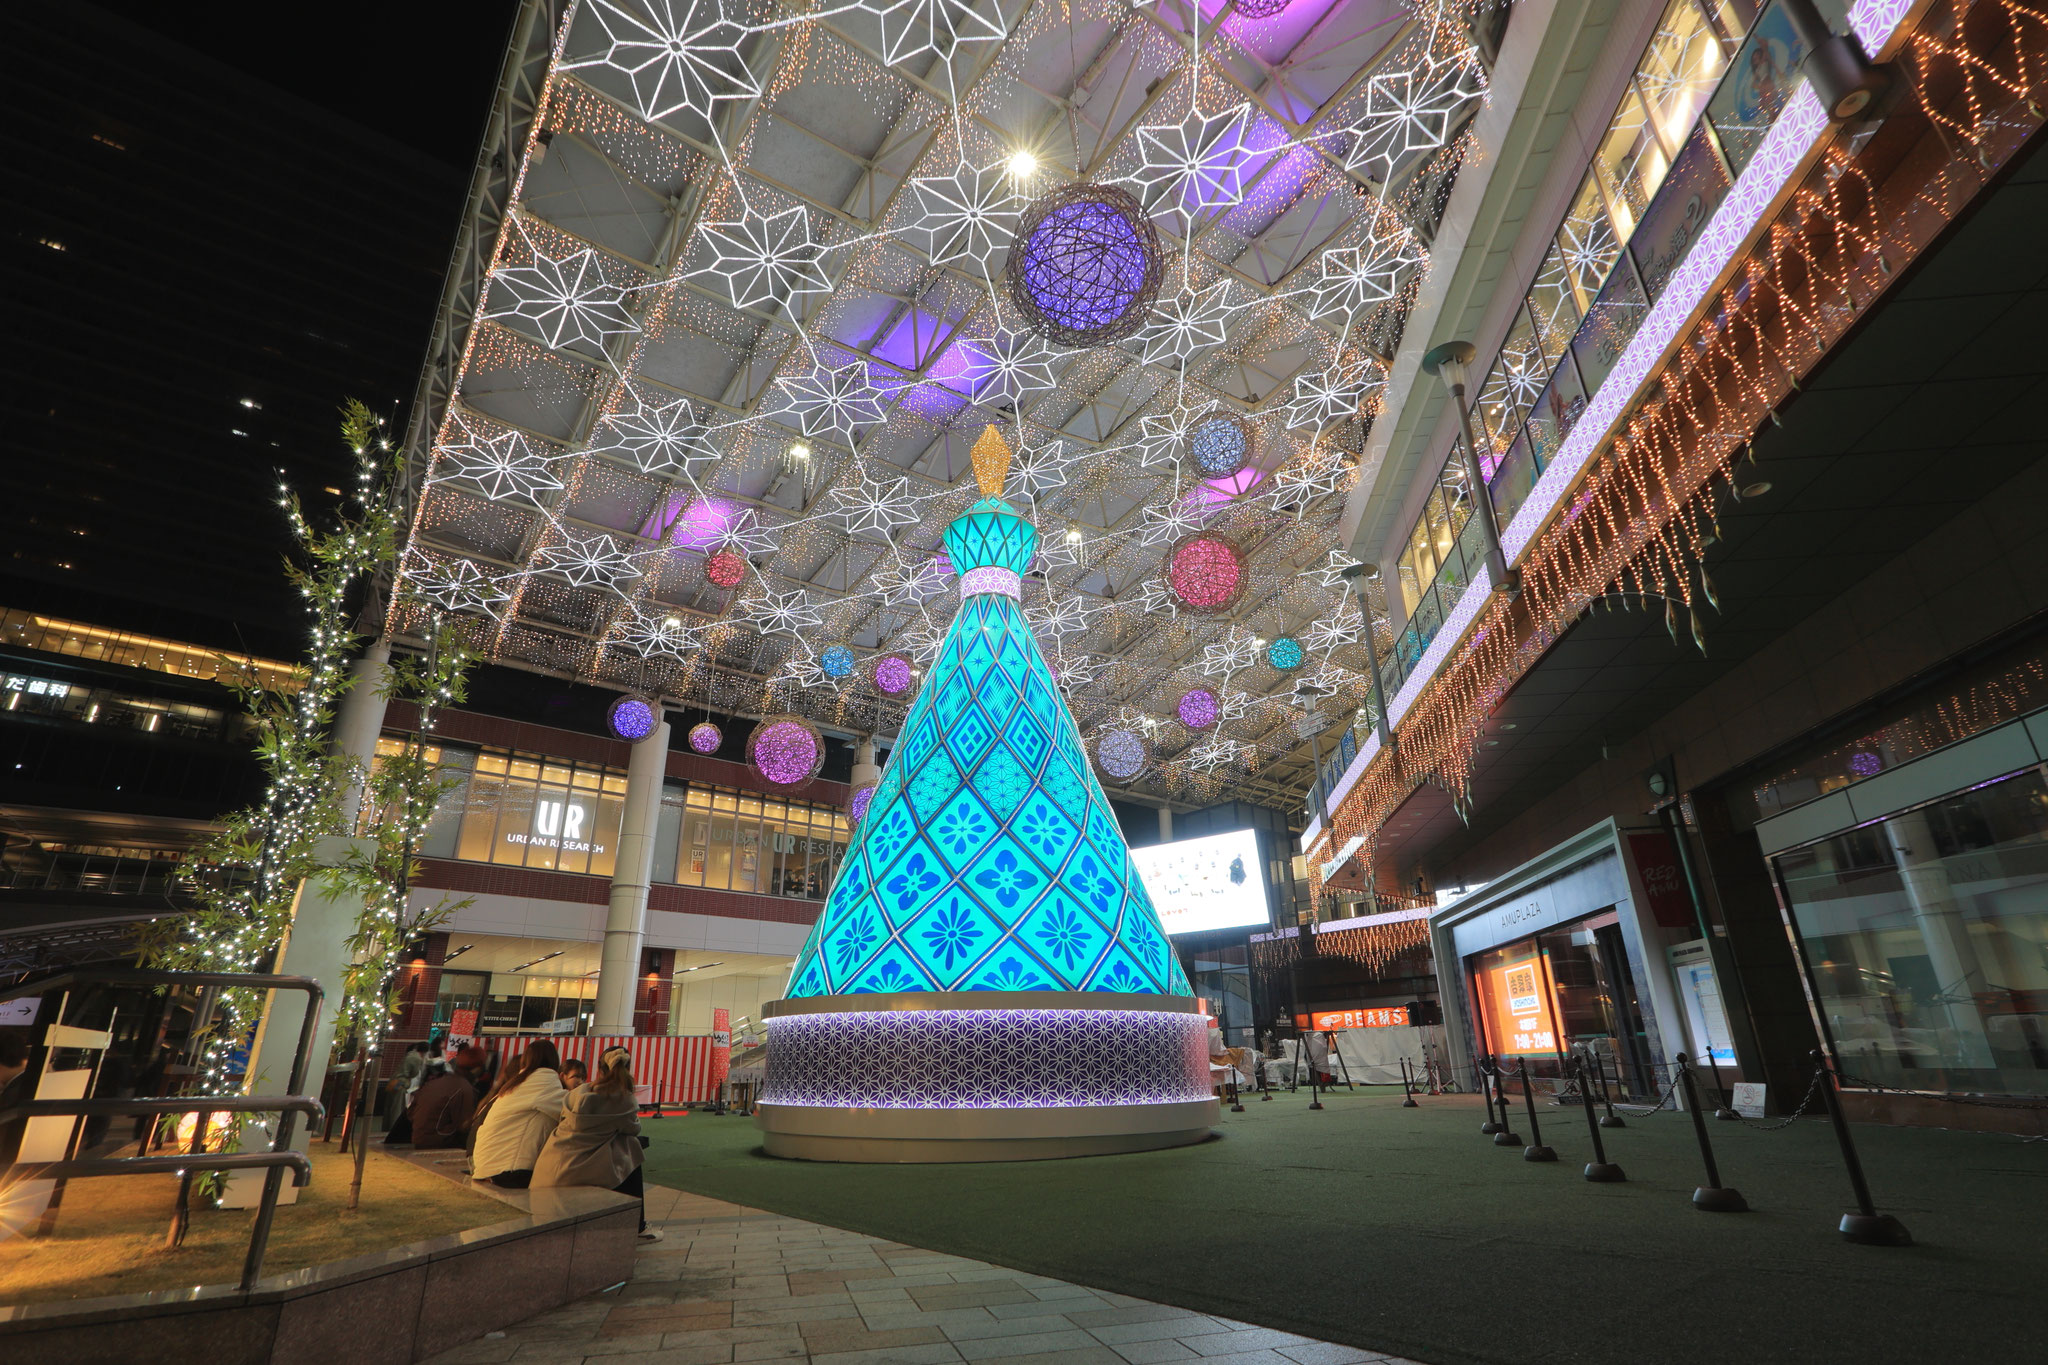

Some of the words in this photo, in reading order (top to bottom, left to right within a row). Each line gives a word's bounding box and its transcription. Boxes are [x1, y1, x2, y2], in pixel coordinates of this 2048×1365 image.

[0, 675, 68, 698] だ歯科
[538, 801, 584, 839] UR
[773, 832, 796, 855] UR
[1643, 865, 1676, 882] RED
[1501, 901, 1542, 928] AMUPLAZA
[1344, 1008, 1403, 1027] BEAMS
